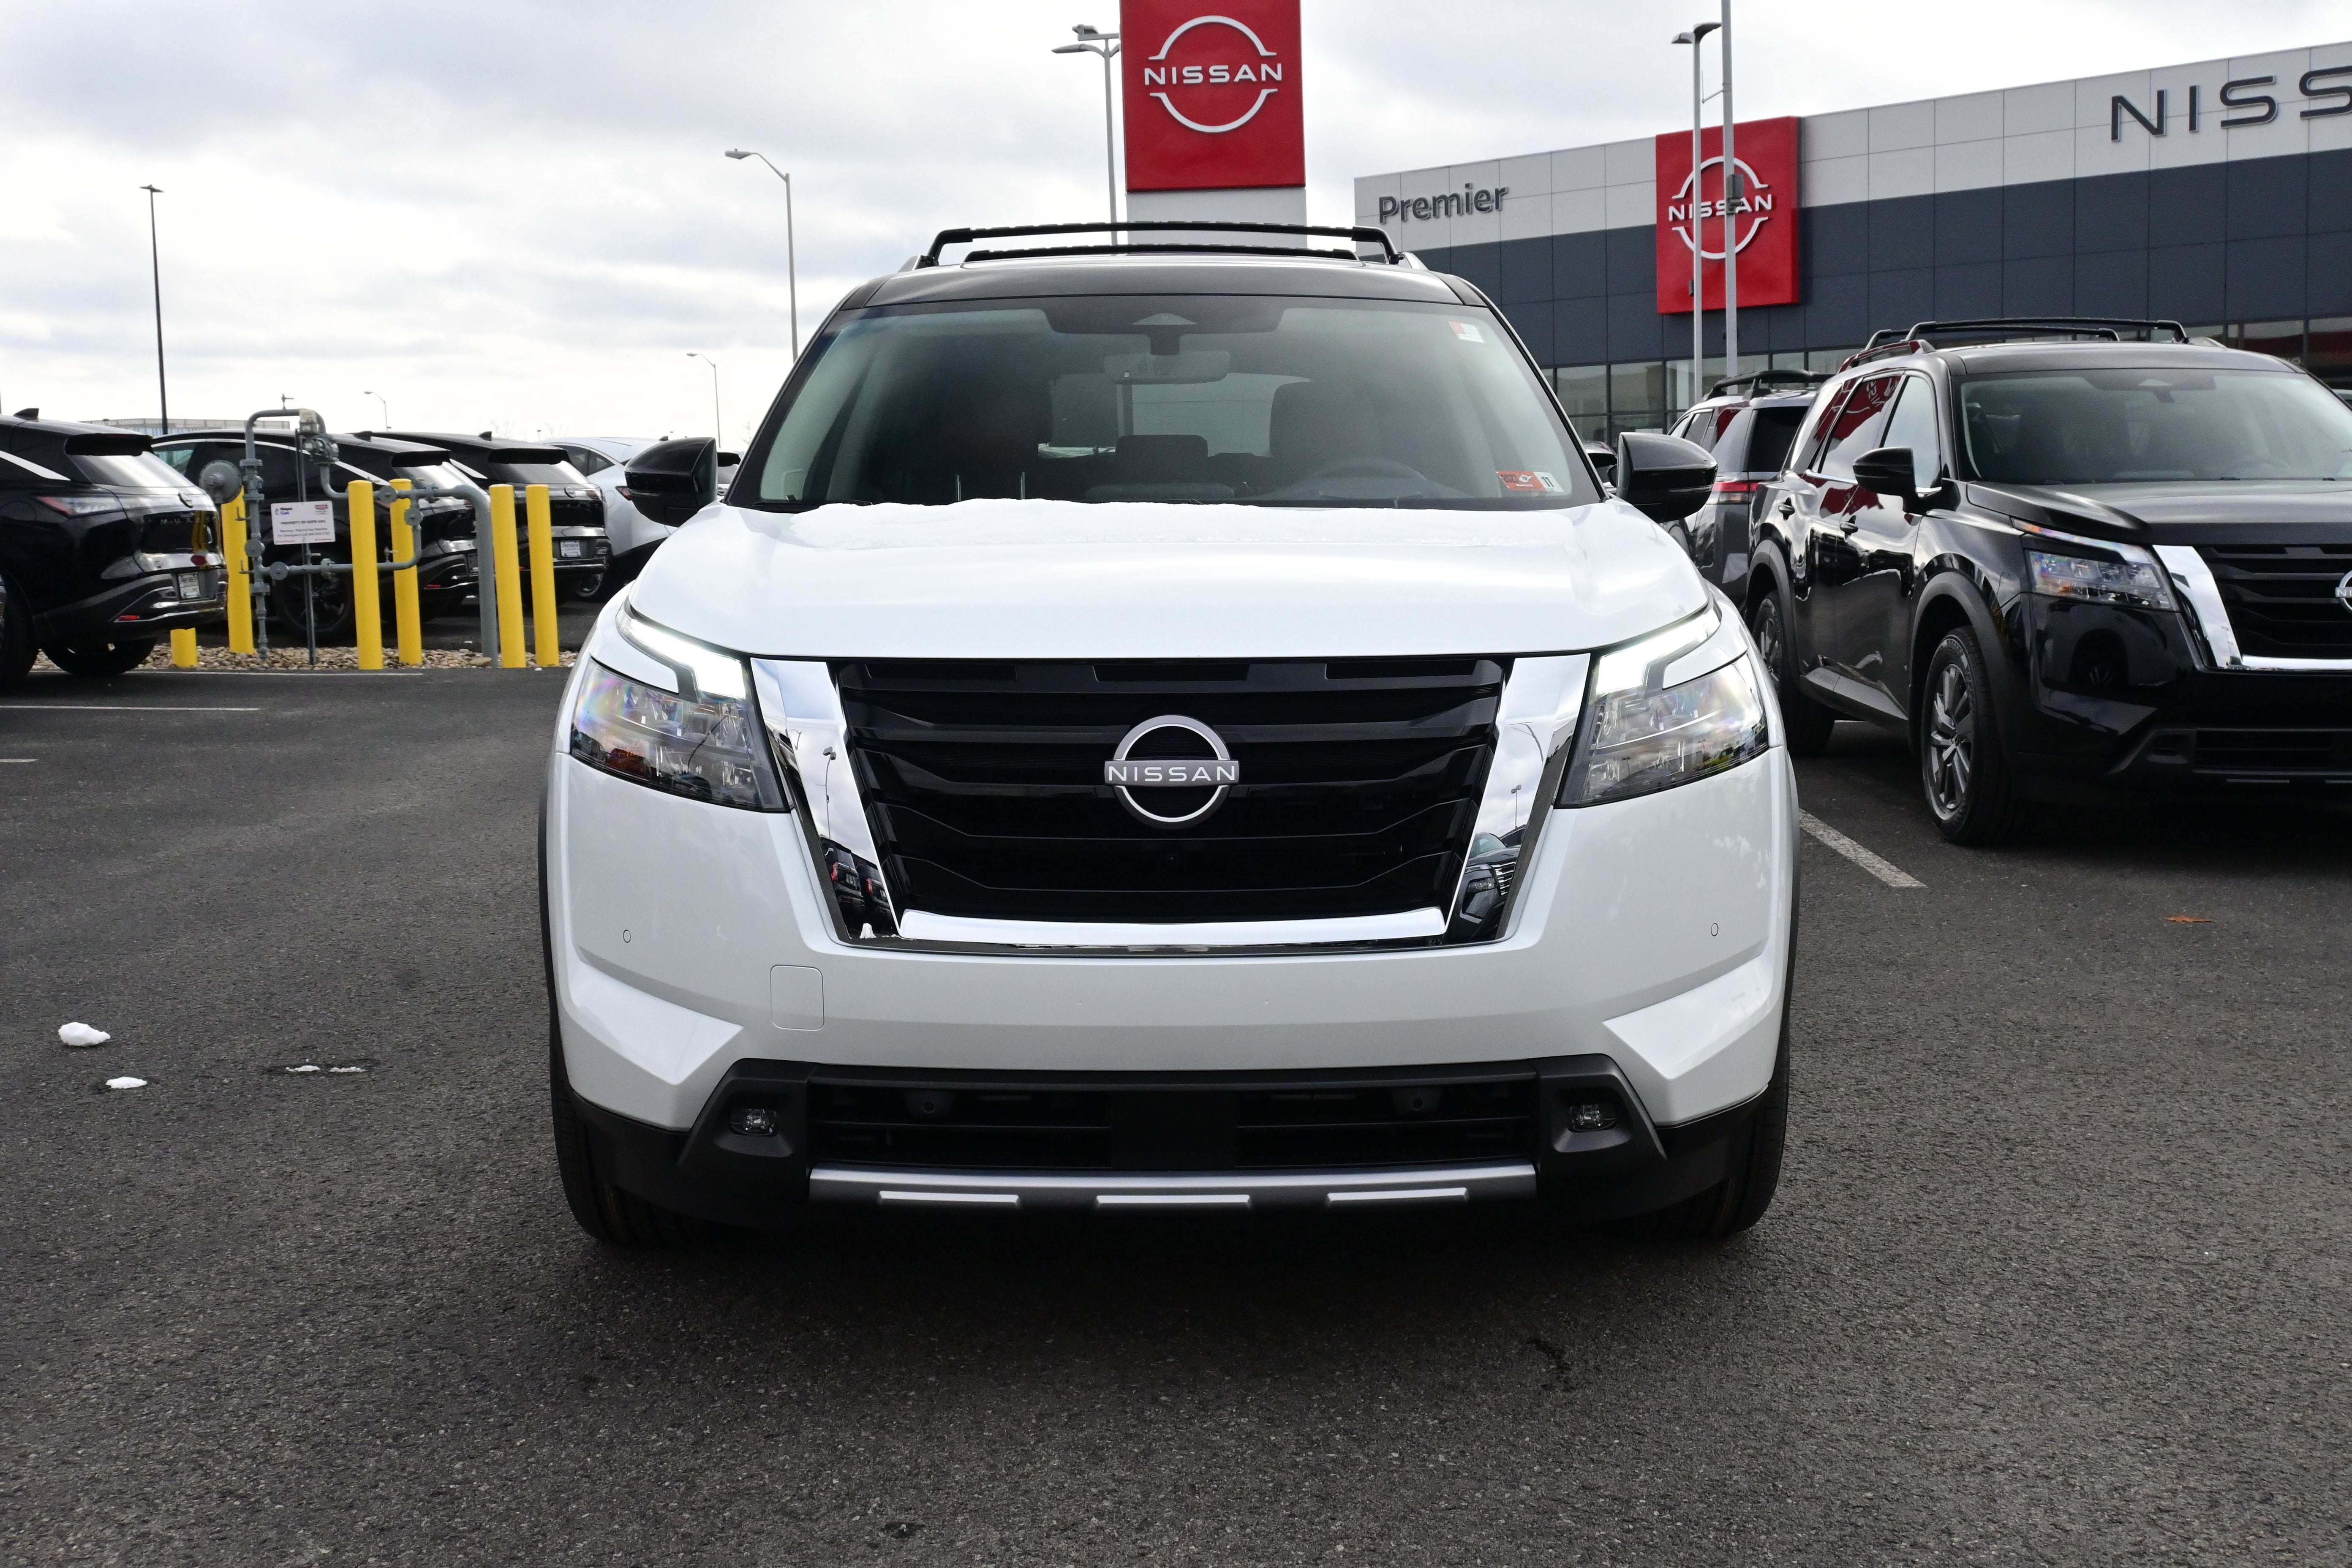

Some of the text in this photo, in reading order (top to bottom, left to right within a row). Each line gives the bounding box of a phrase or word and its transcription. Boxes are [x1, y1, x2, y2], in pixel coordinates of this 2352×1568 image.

[1144, 63, 1282, 85] NISSAN
[1379, 182, 1509, 224] Premier
[1541, 476, 1554, 487] 11
[1108, 765, 1236, 781] NISSAN
